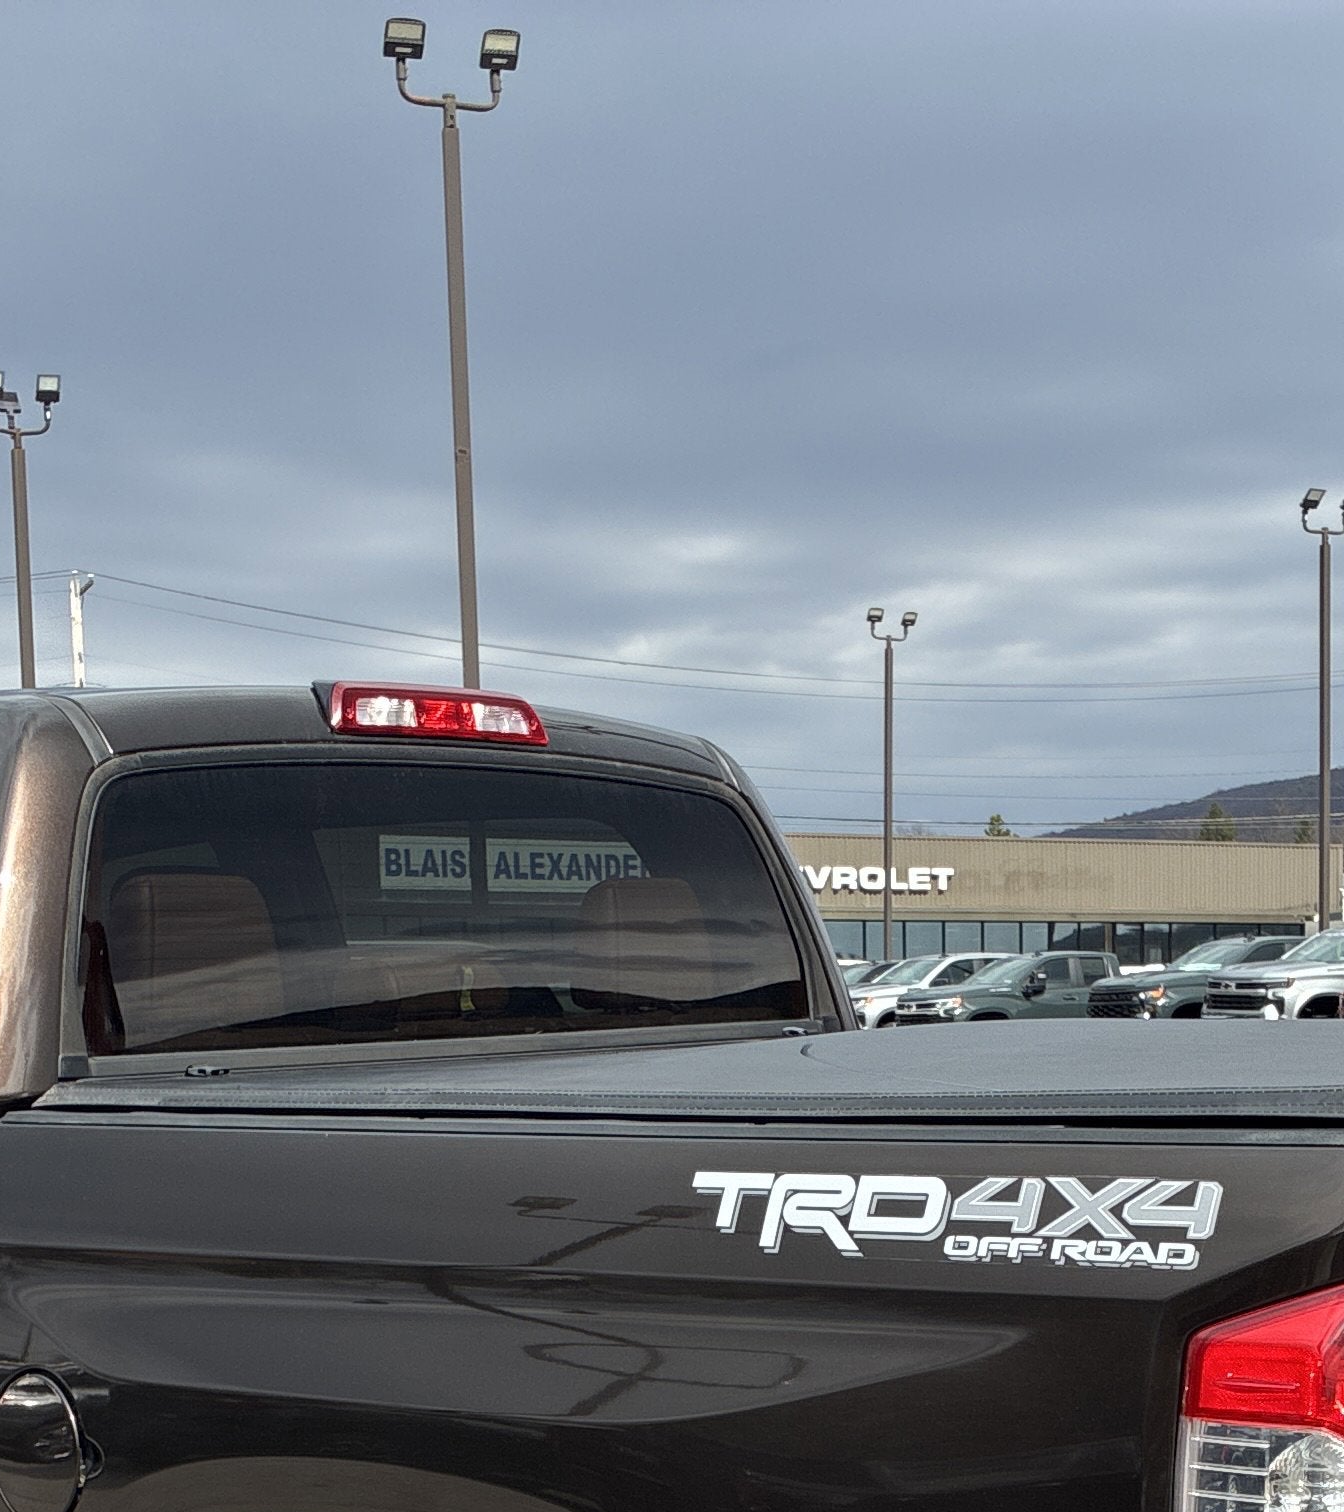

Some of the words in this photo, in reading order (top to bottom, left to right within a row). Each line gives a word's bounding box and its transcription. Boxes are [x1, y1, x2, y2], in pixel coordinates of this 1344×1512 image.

[383, 848, 467, 879] BLAIS
[799, 865, 955, 891] VROLET
[692, 1171, 951, 1257] TRD
[950, 1175, 1223, 1240] 4X4
[943, 1235, 1047, 1263] OFF
[1049, 1237, 1200, 1271] ROAD
